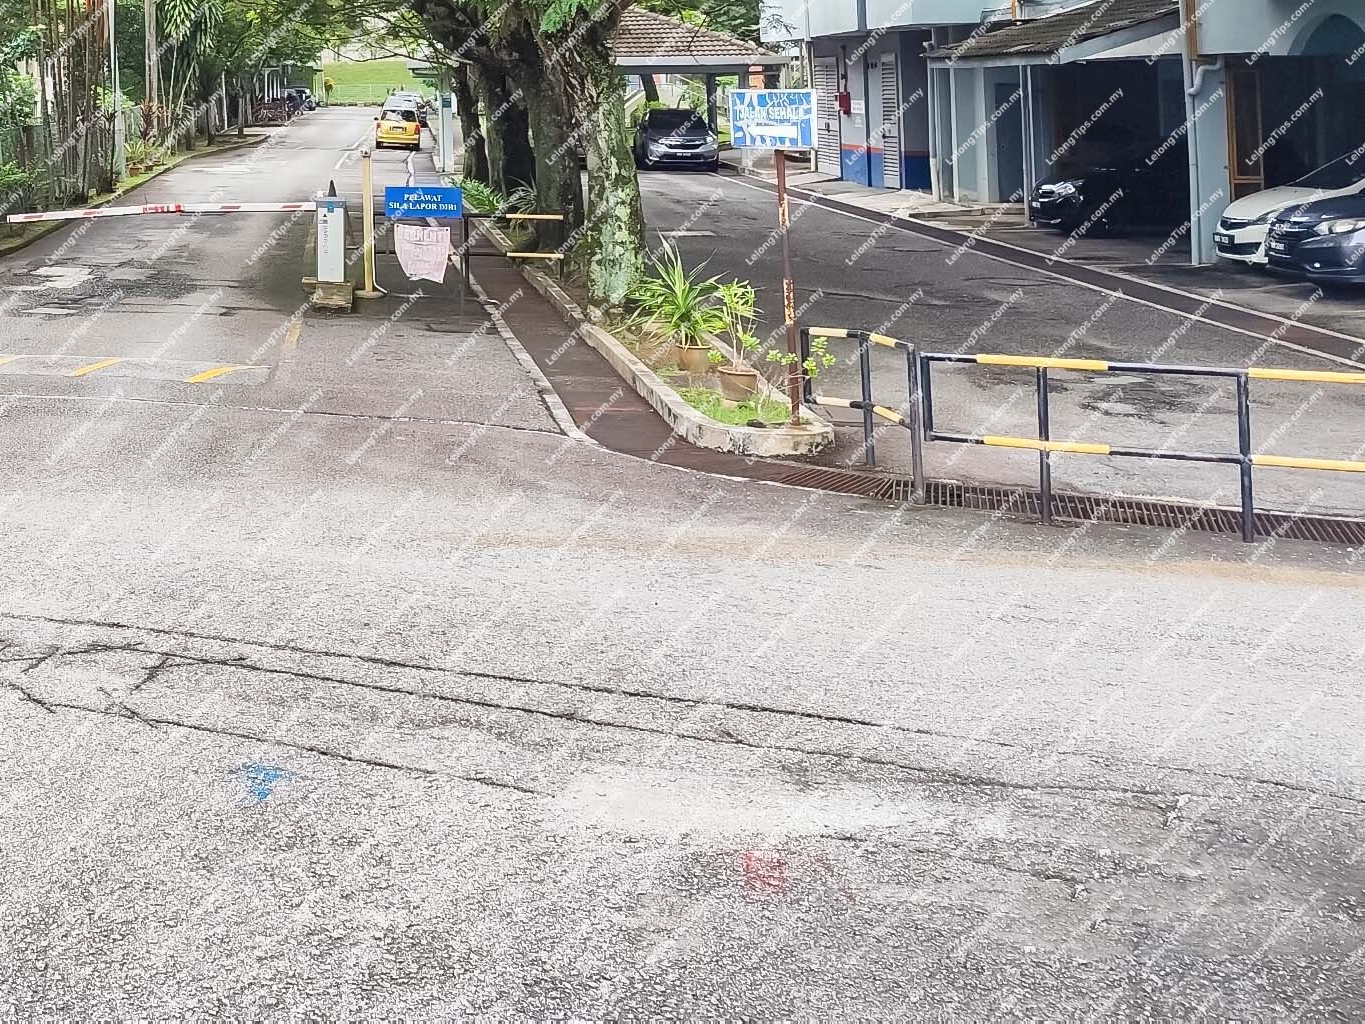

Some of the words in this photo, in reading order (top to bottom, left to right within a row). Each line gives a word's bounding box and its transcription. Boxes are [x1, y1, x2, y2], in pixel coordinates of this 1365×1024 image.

[403, 193, 442, 202] PELAWAT
[388, 201, 408, 209] SILA
[439, 203, 457, 211] DIRI
